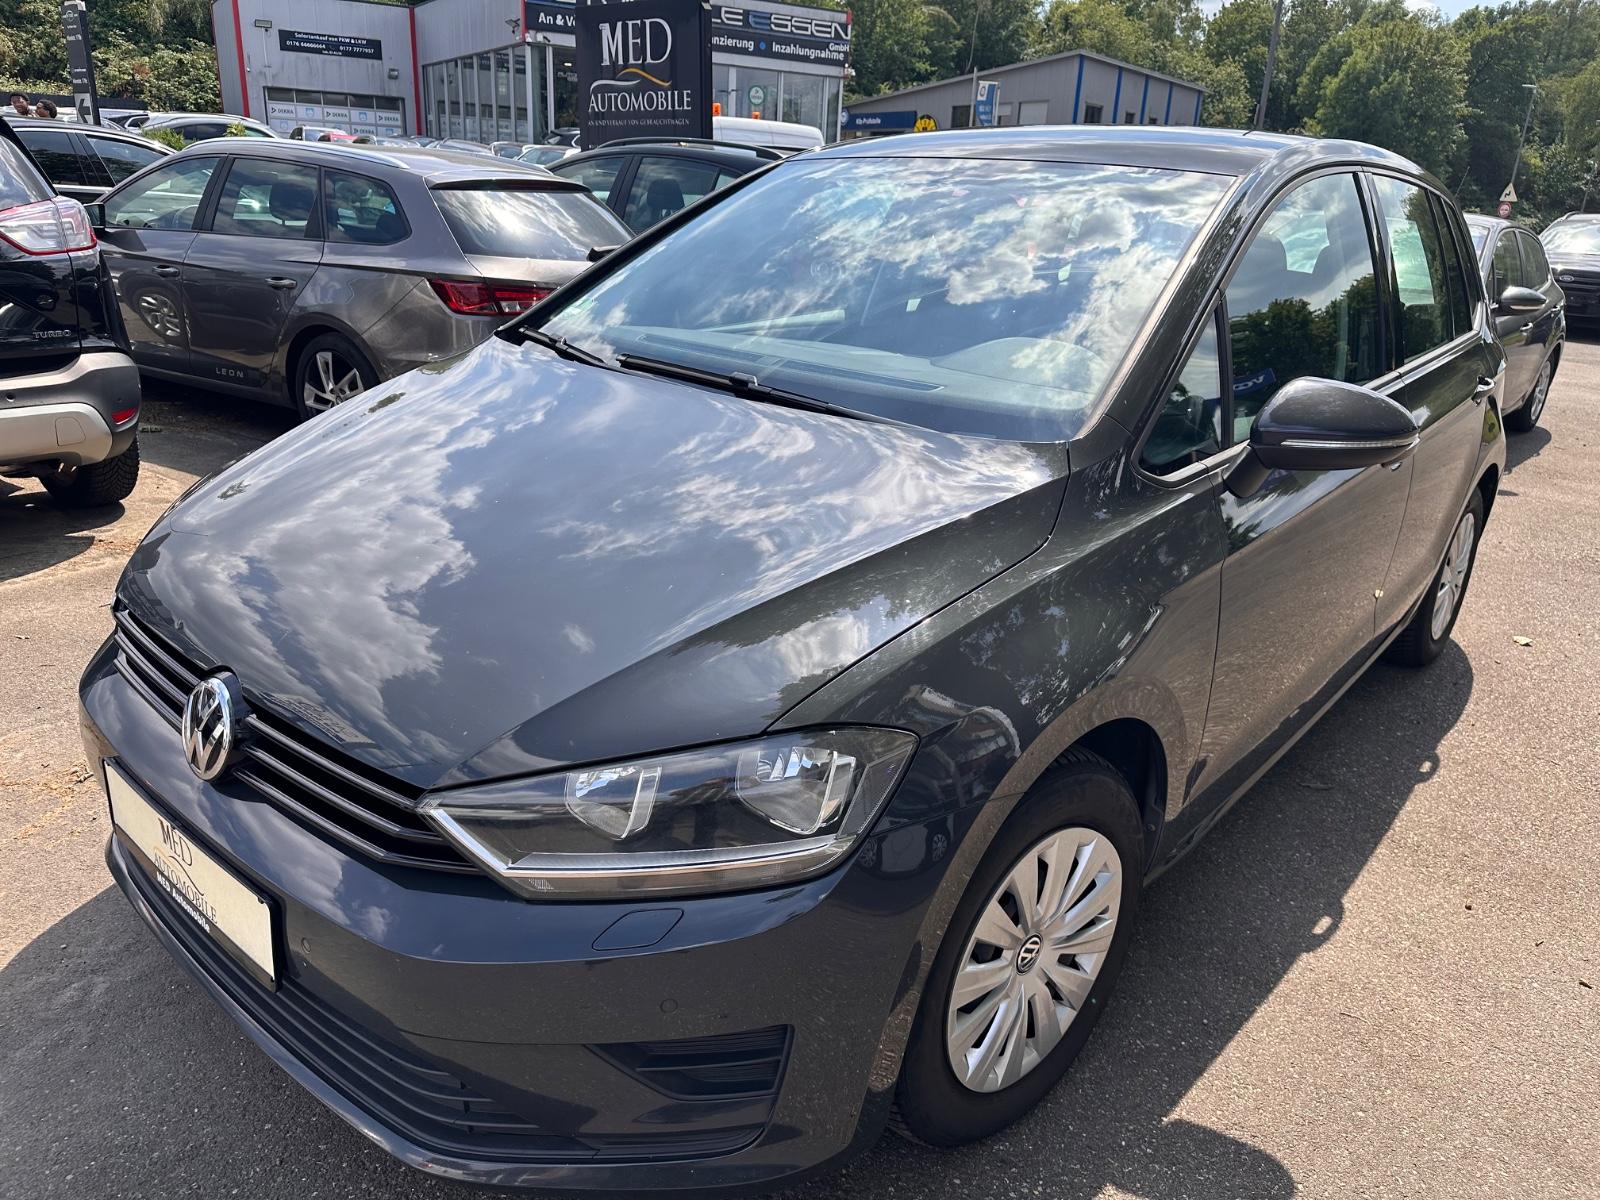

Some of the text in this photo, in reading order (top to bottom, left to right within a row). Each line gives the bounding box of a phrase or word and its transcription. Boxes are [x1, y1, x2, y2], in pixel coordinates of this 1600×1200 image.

[538, 12, 553, 24] An
[555, 14, 564, 26] &
[749, 11, 851, 40] ESSEN
[599, 17, 672, 66] MED
[772, 42, 844, 60] Inzahlungnahme
[829, 43, 850, 52] GmbH
[588, 90, 692, 112] AUTOMOBILE
[32, 330, 72, 338] TURBO
[215, 367, 244, 378] LEON
[158, 818, 193, 866] MED
[154, 852, 218, 924] AUTOMOBILE
[156, 871, 210, 933] MED Automobile
